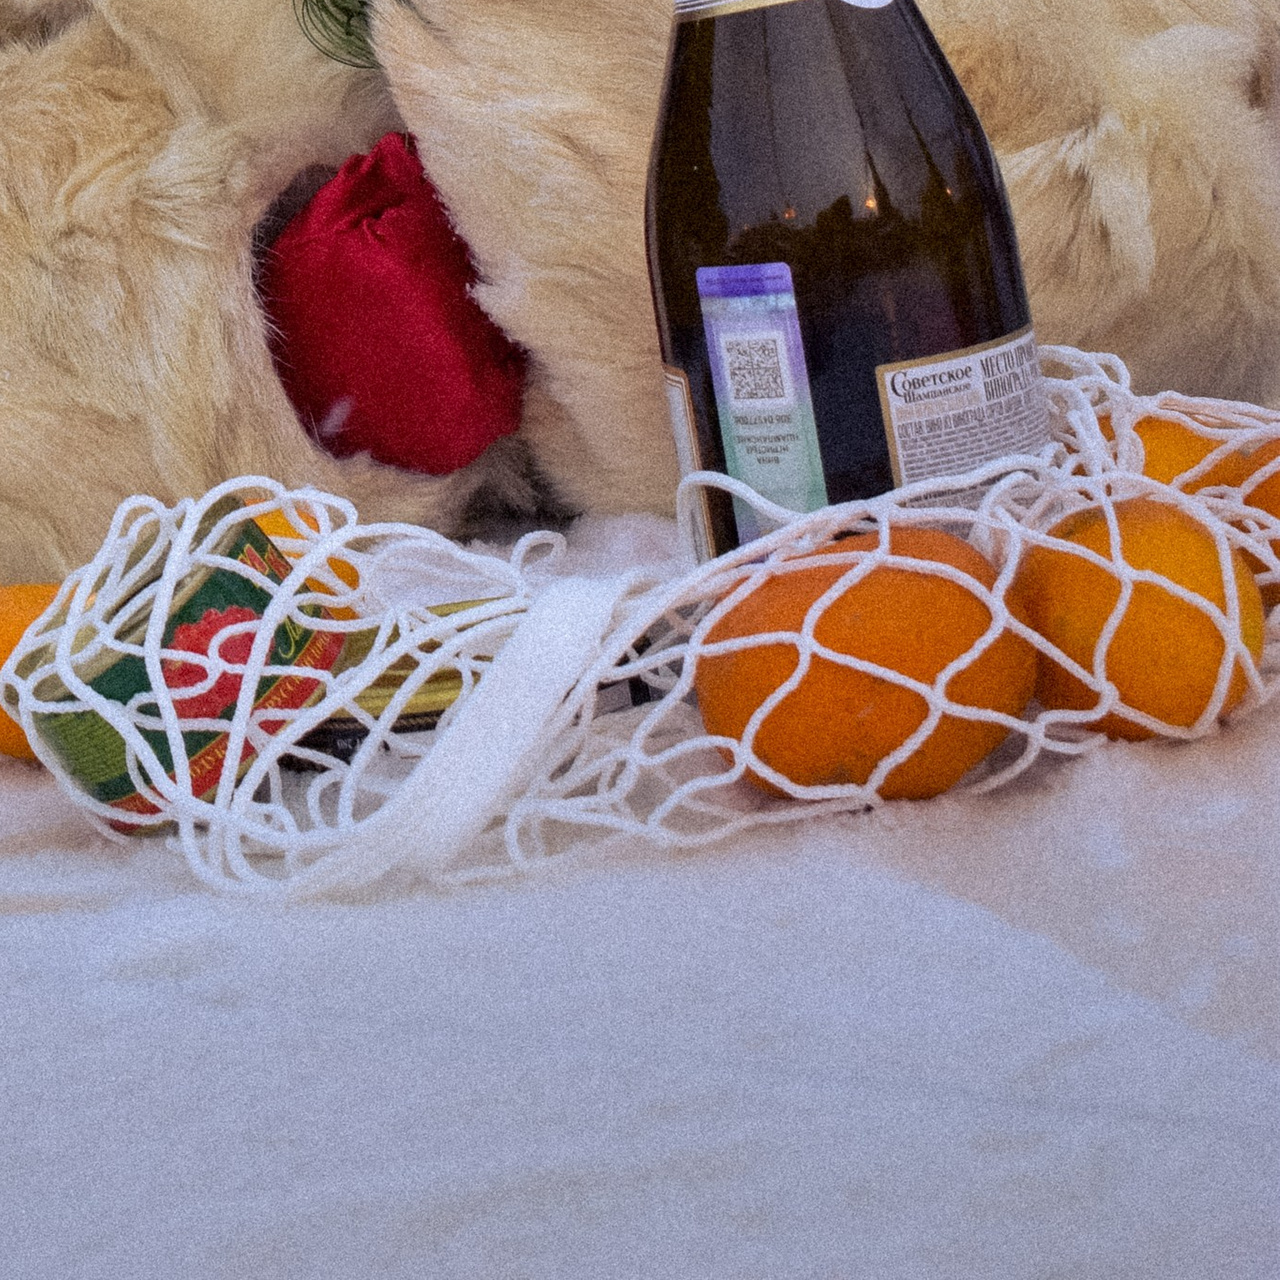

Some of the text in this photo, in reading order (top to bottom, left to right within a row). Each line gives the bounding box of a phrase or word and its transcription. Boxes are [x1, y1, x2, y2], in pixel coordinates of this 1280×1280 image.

[980, 350, 1014, 378] МЕСТО
[891, 366, 972, 397] Советское
[903, 382, 971, 403] Шампанское
